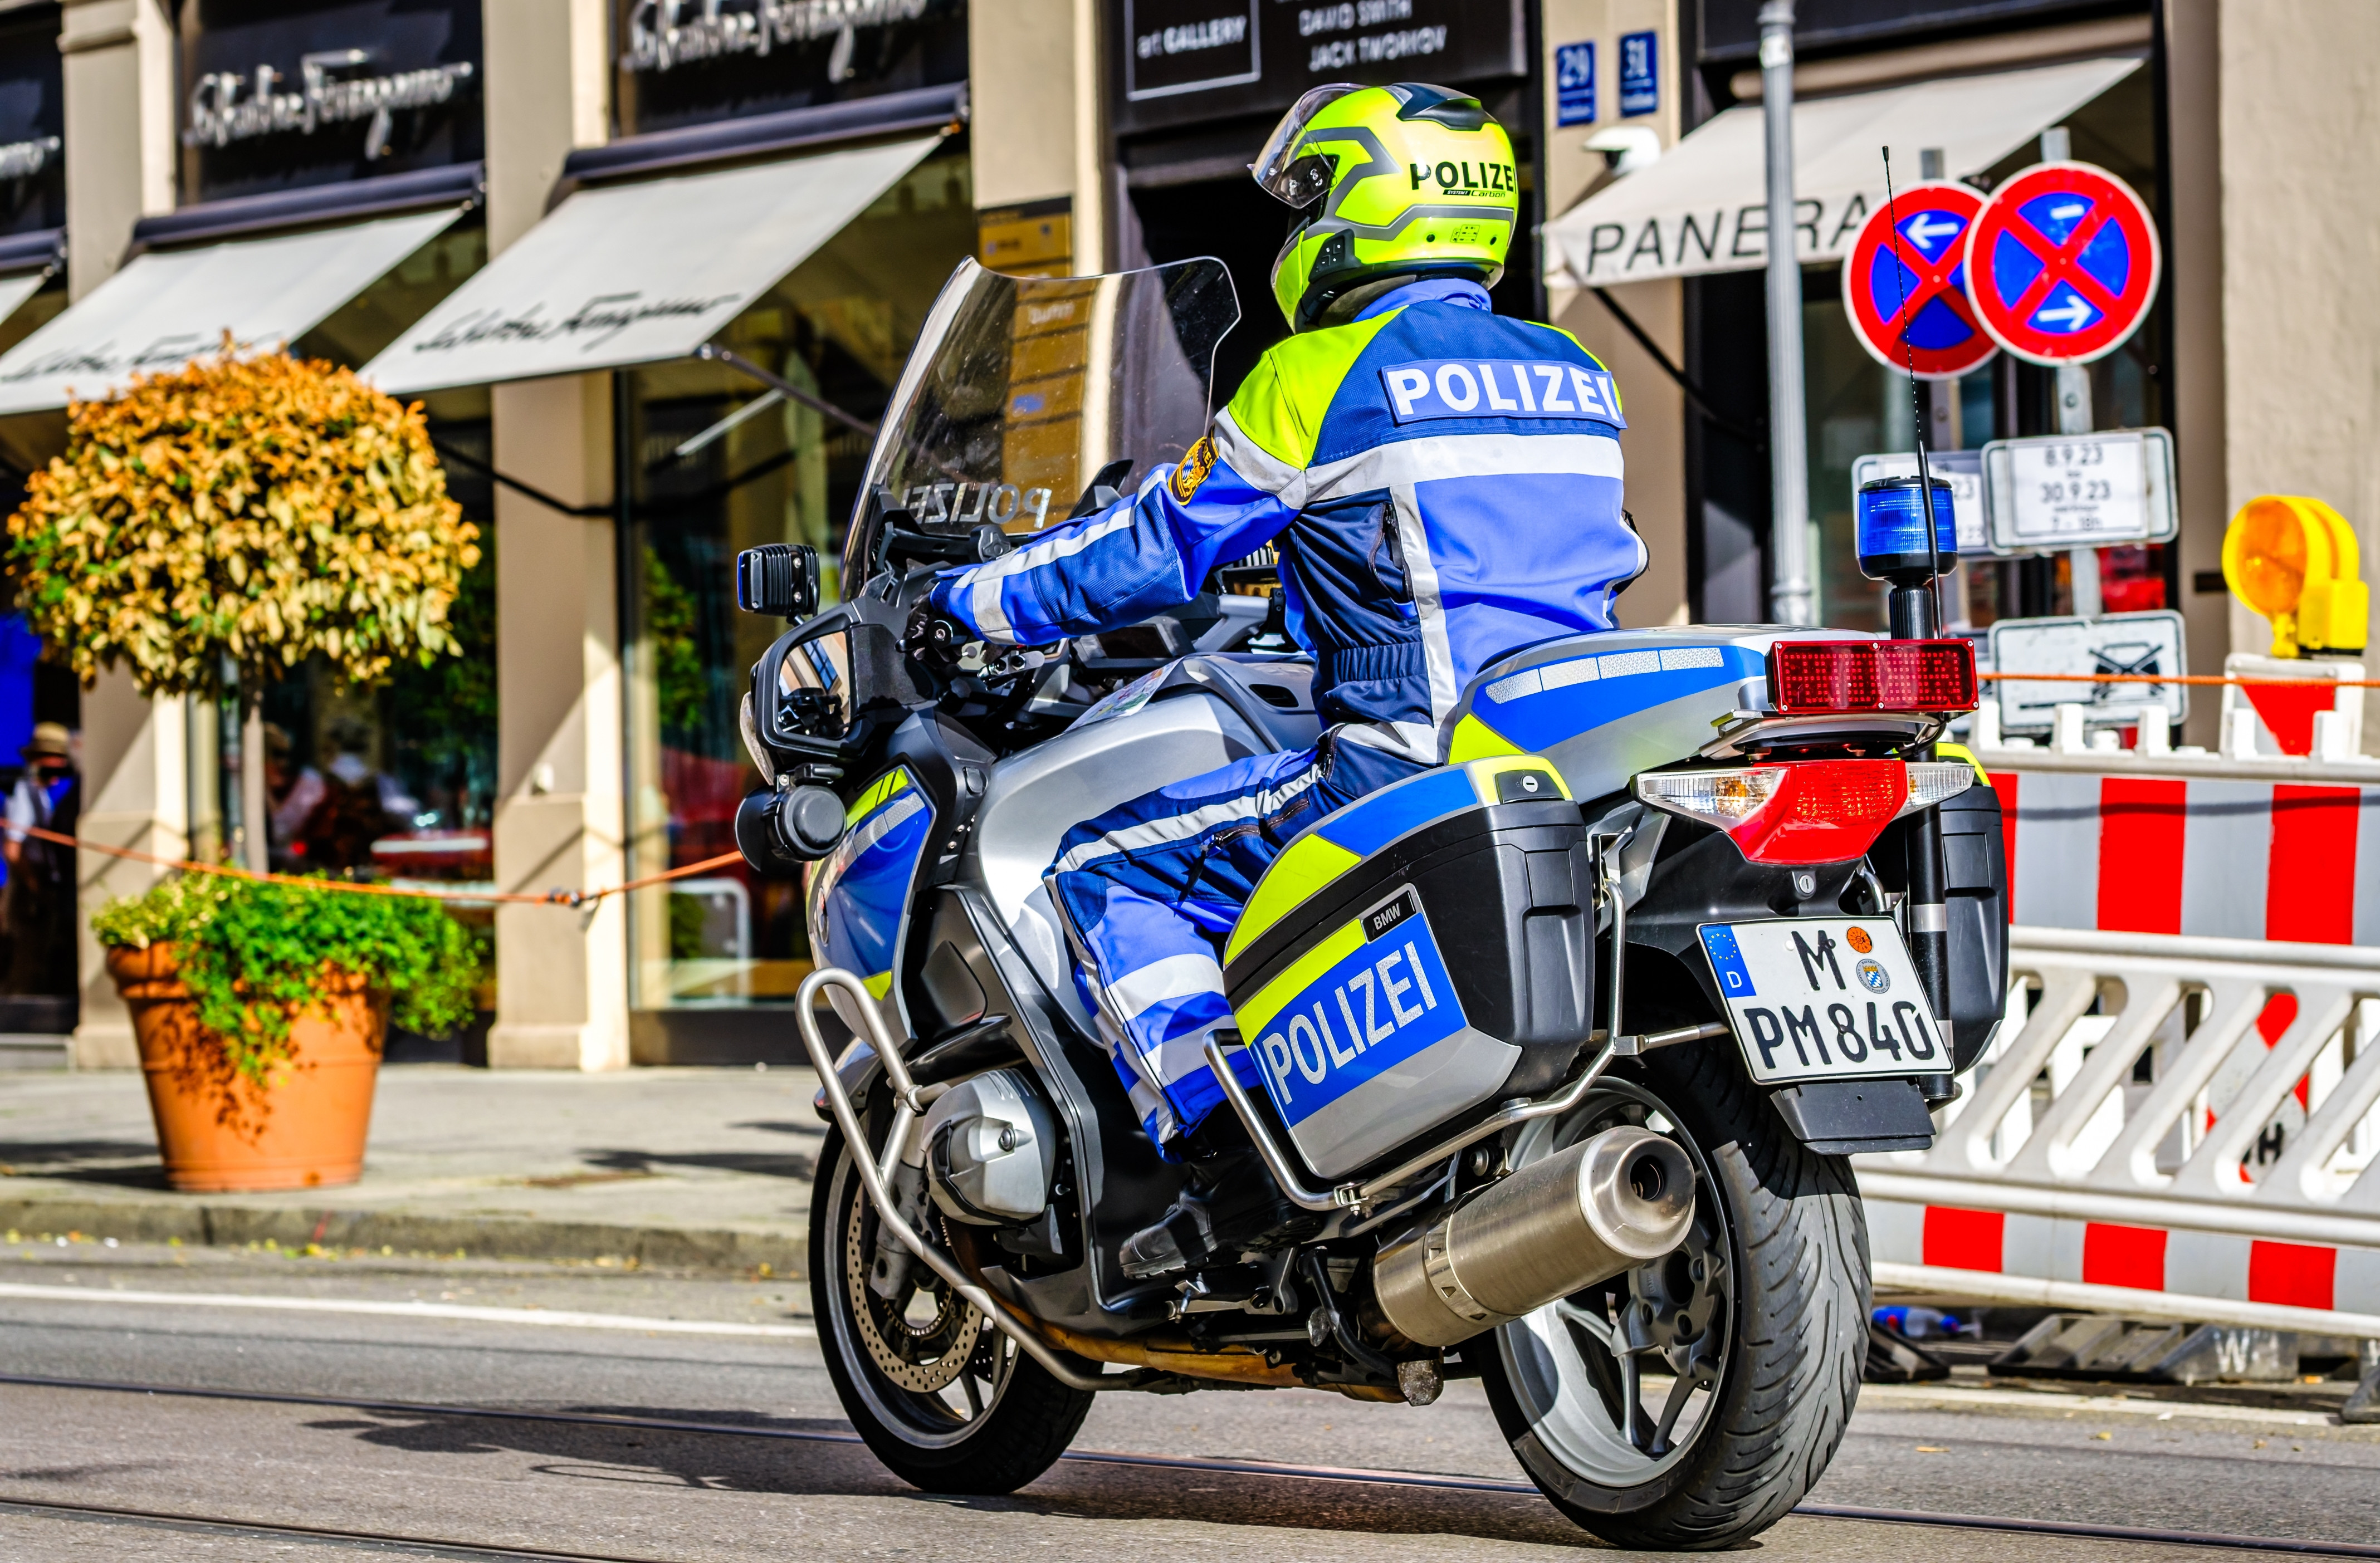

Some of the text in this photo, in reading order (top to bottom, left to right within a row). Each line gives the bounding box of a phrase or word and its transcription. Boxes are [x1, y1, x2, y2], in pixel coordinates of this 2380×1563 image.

[1164, 14, 1247, 54] GALLERY
[1299, 3, 1355, 36] DAVID
[1309, 40, 1356, 72] JACK
[1561, 47, 1590, 87] 29
[1625, 39, 1648, 79] 31
[1410, 161, 1517, 194] POLIZE
[1387, 363, 1620, 422] POLIZEI
[1373, 903, 1400, 930] BMW
[1726, 971, 1742, 989] D
[1792, 930, 1846, 991] M
[1262, 940, 1438, 1105] POLIZEI
[1743, 1001, 1935, 1070] PM 840
